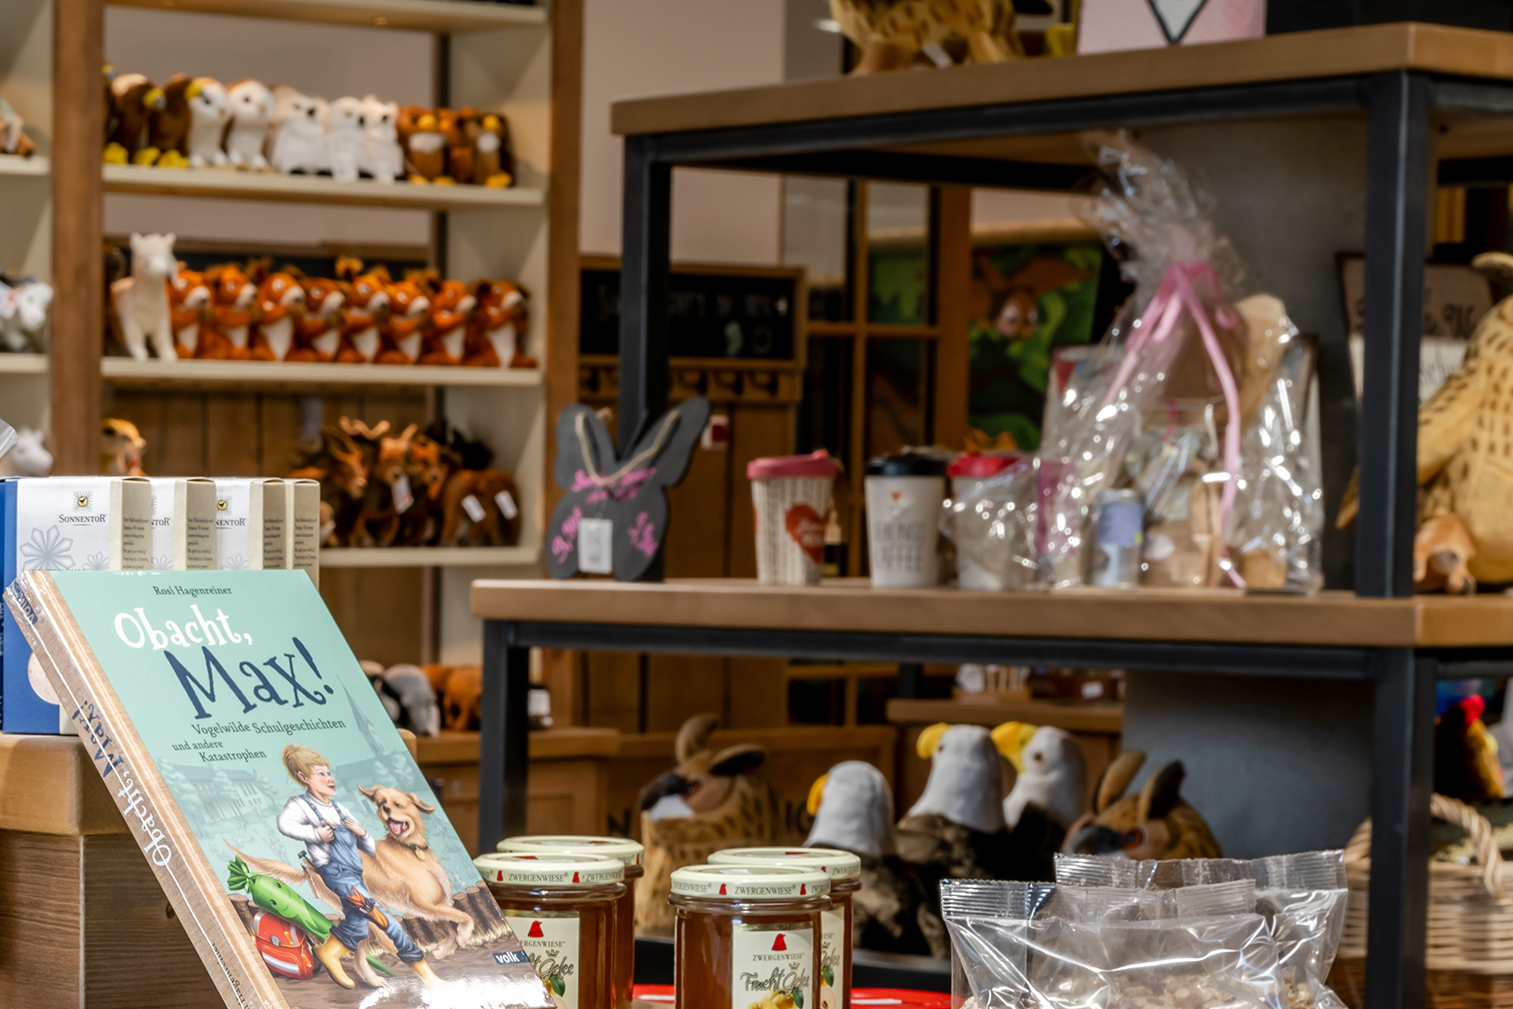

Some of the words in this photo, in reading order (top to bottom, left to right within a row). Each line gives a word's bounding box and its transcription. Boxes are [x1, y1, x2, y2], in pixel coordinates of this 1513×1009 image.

[153, 585, 174, 596] Rosi
[175, 585, 232, 598] Hagenreiner
[114, 604, 252, 650] Obacht,
[163, 636, 334, 719] Max!
[191, 722, 250, 738] Vogelwilde
[251, 718, 346, 736] Schulgeschichten
[172, 741, 192, 752] und
[193, 739, 223, 750] andere
[200, 748, 267, 763] Katastrophen
[496, 952, 520, 965] volk
